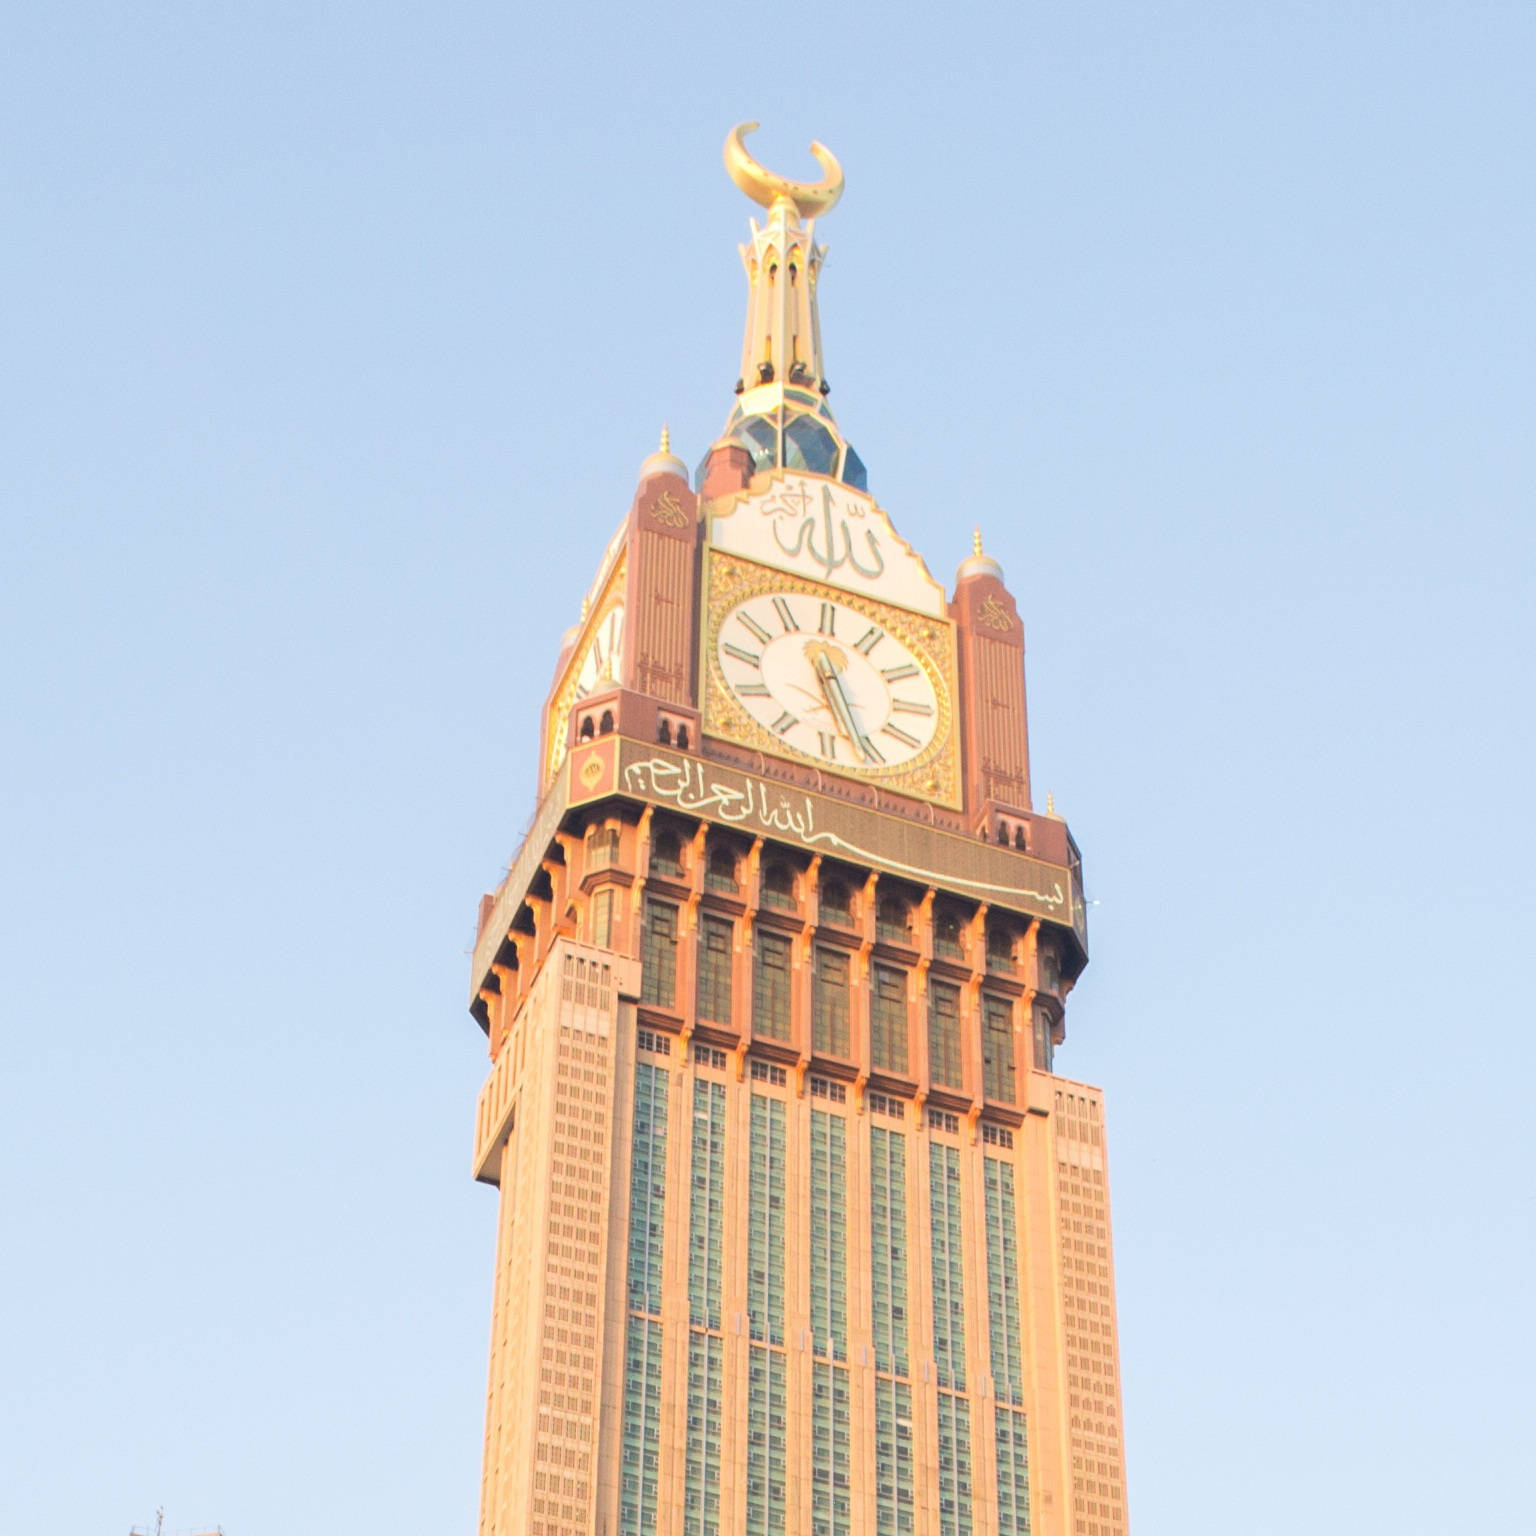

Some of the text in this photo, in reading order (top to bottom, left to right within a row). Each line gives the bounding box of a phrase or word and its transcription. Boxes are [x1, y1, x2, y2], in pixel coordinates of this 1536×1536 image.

[772, 484, 884, 580] الله
[624, 758, 1064, 910] بسم الله الرحمن الرحيم
